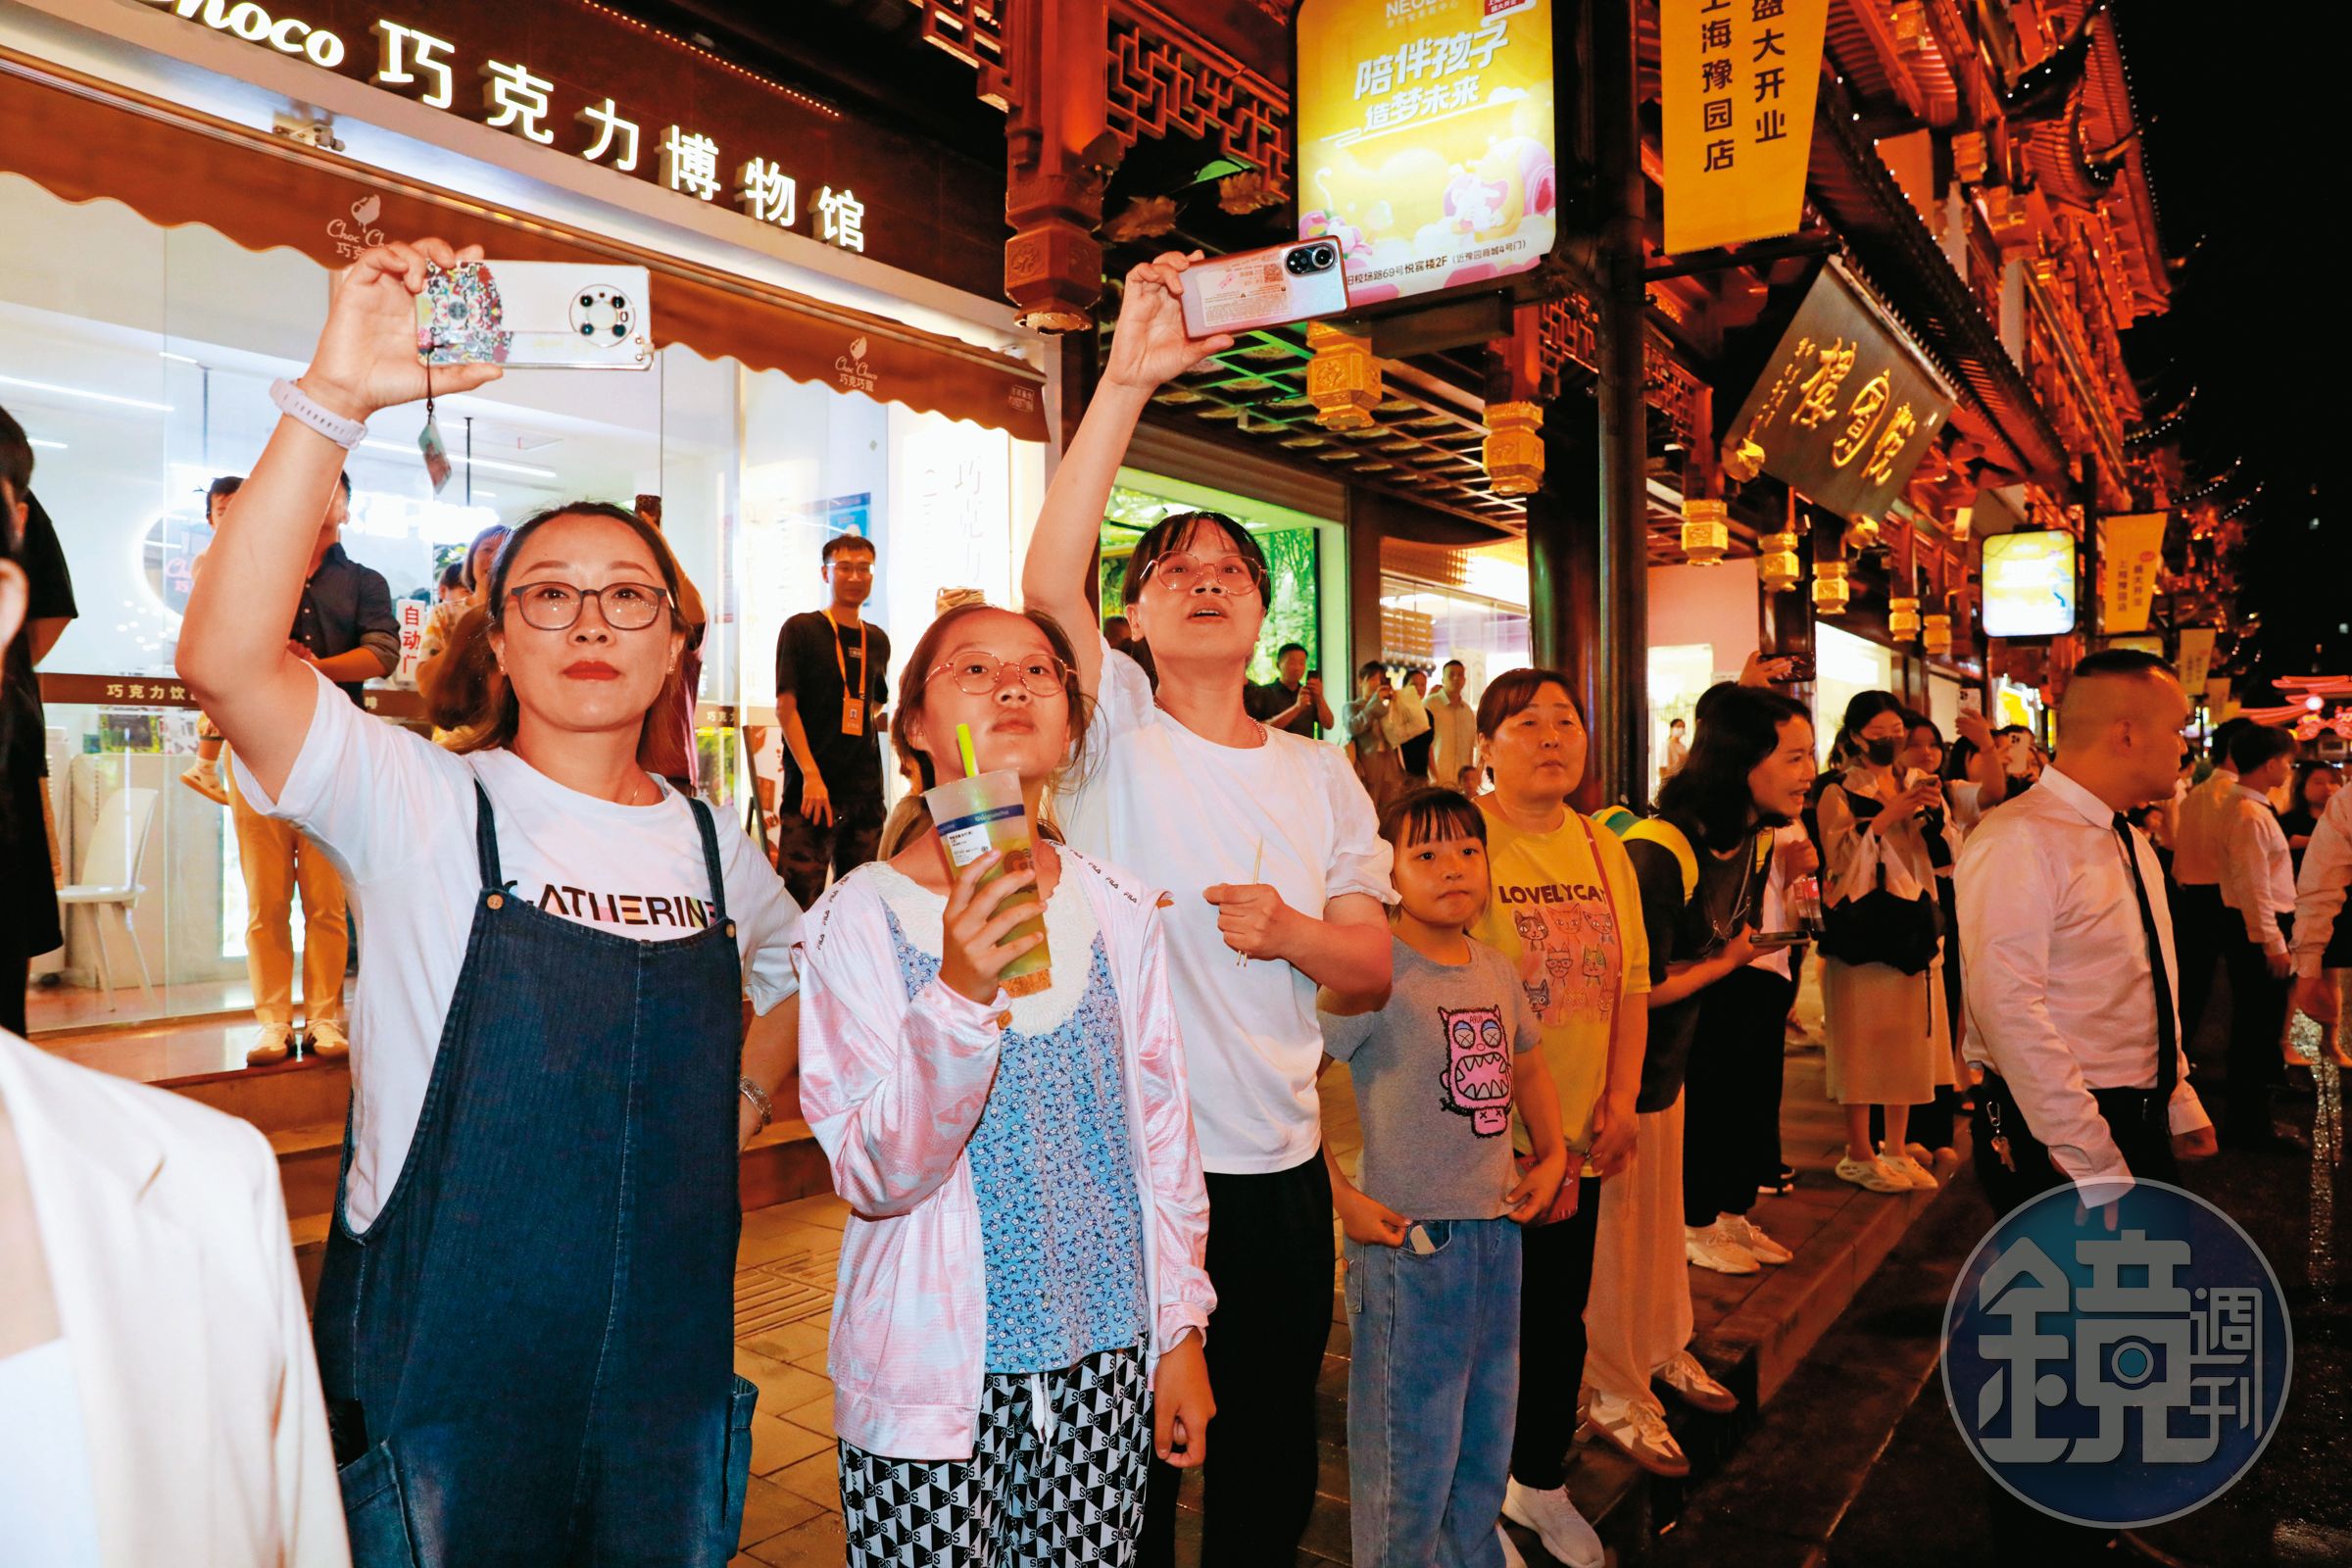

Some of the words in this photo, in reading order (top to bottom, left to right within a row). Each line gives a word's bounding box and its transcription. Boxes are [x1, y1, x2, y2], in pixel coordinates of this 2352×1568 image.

[1353, 20, 1510, 102] 陪伴孩子
[1363, 74, 1480, 133] 造梦未来
[377, 19, 866, 253] 巧克力博物馆
[326, 219, 362, 243] Choc
[107, 684, 196, 701] 巧克力饮
